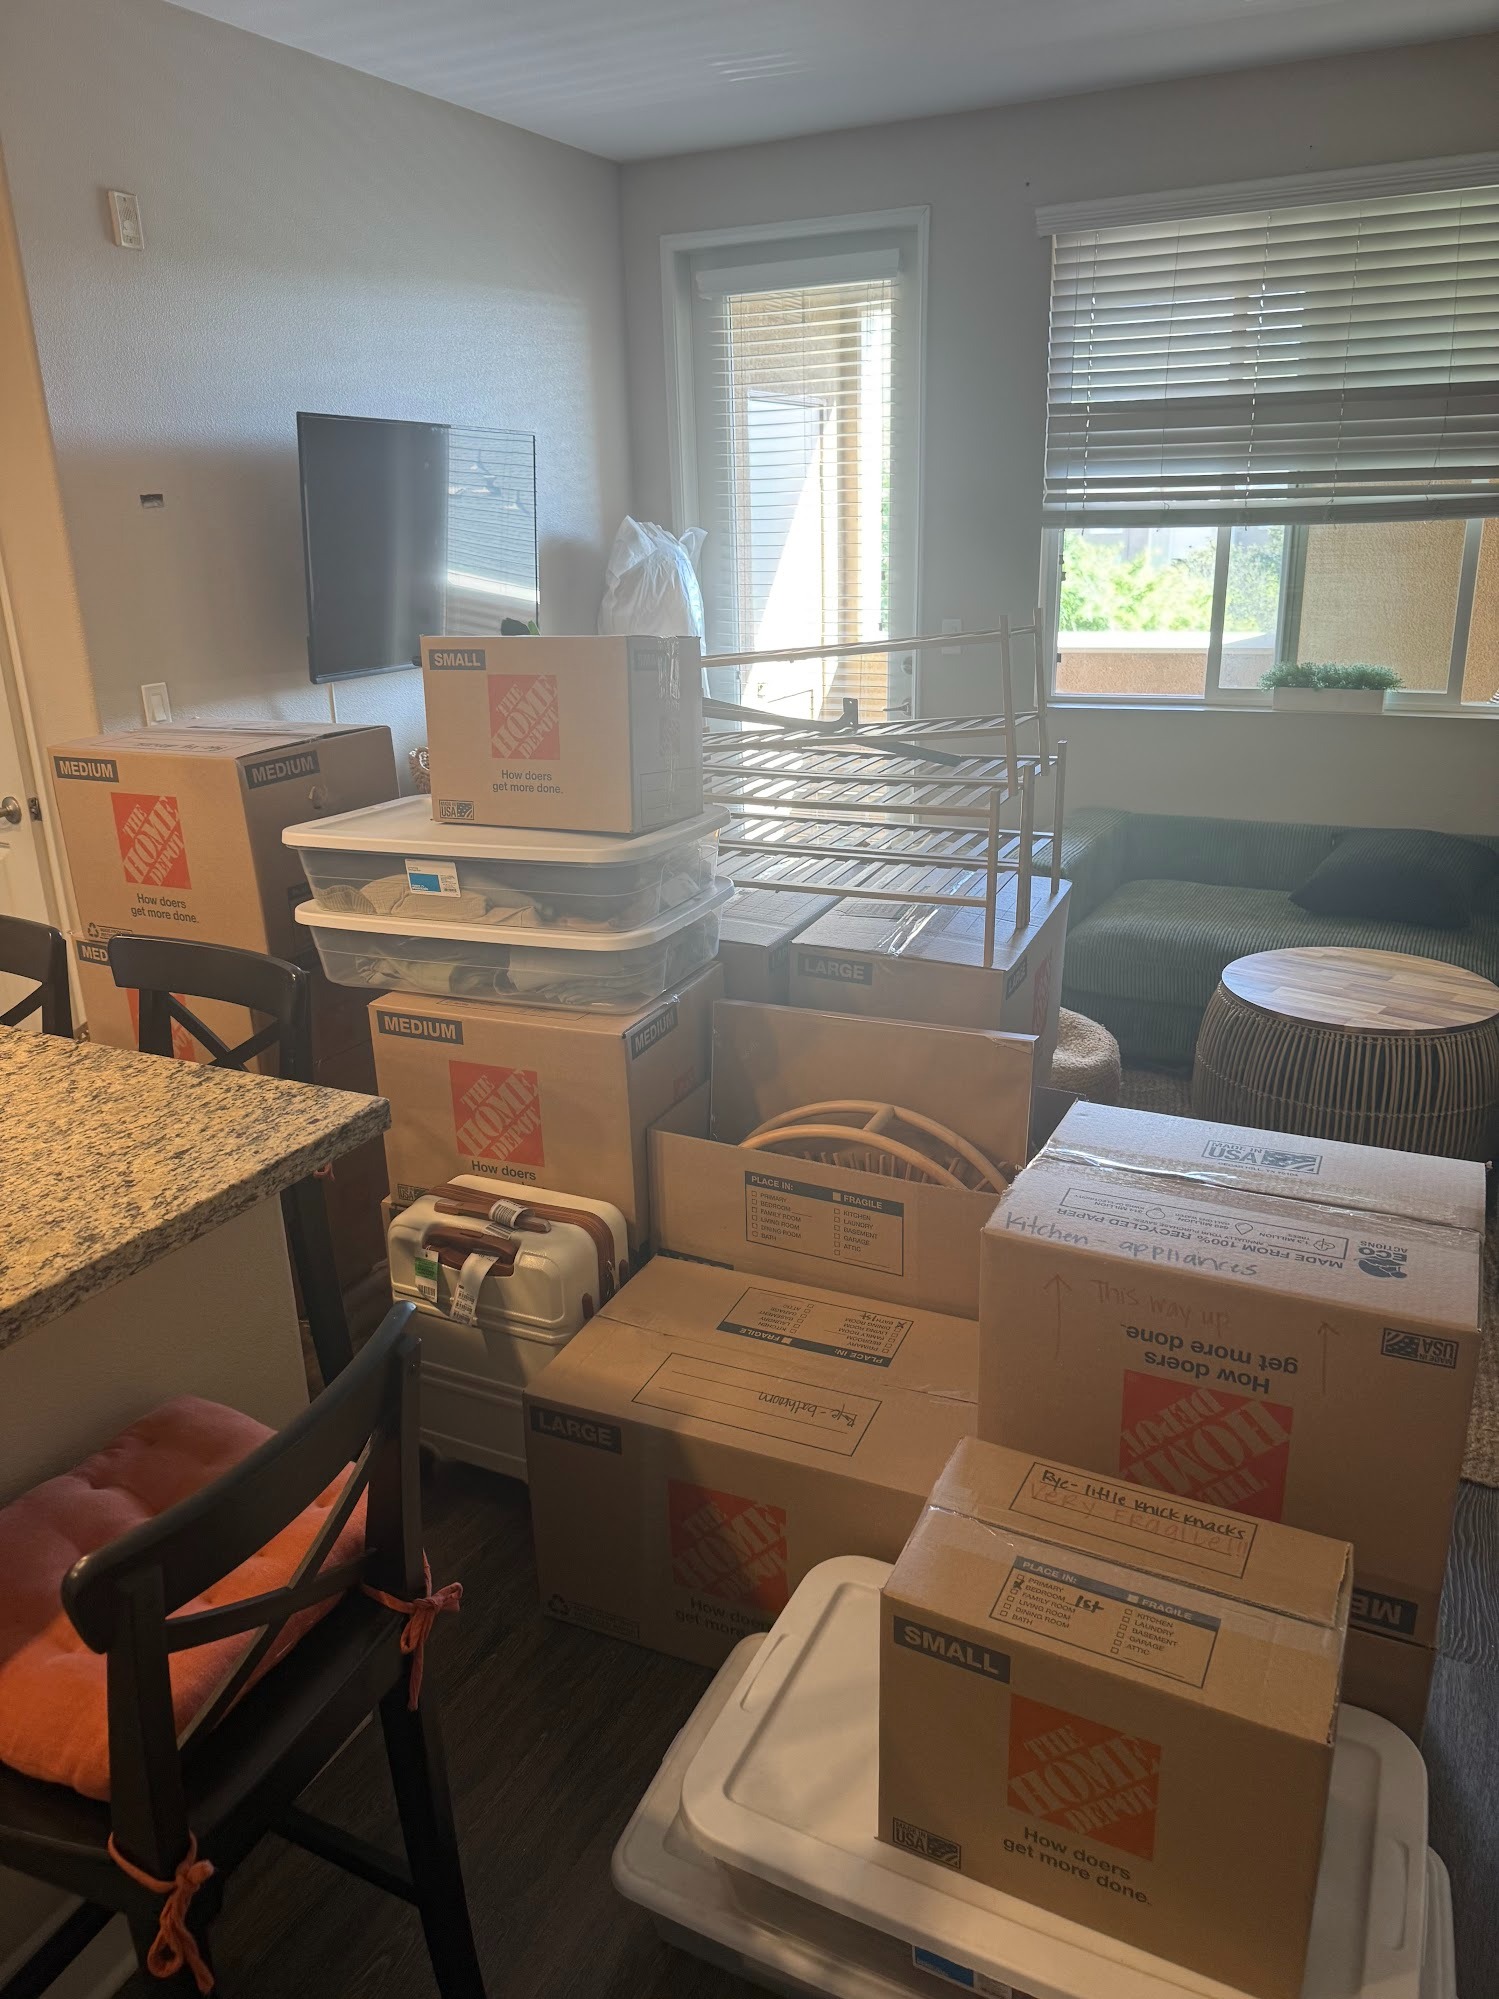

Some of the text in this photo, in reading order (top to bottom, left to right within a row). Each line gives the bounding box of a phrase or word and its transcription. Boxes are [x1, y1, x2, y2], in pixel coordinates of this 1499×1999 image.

[434, 652, 481, 667] SMALL
[495, 683, 525, 717] THE
[491, 673, 558, 759] HOME
[519, 707, 561, 759] DEPOT
[58, 760, 113, 779] MEDIUM
[251, 755, 315, 784] MEDIUM
[501, 769, 552, 781] How doers
[492, 782, 564, 795] get more done.
[441, 806, 457, 818] USA
[122, 803, 148, 840] THE
[122, 796, 180, 884] HOME
[149, 831, 184, 886] DEPOT
[136, 893, 187, 909] How doers
[130, 906, 200, 924] get more done.
[81, 946, 109, 962] MED
[804, 956, 865, 980] LARGE
[384, 1015, 457, 1040] MEDIUM
[634, 1011, 675, 1051] MEDIUM
[460, 1073, 498, 1112] THE
[456, 1067, 541, 1158] HOME
[490, 1106, 541, 1163] DEPOT
[1208, 1146, 1258, 1163] USA
[1211, 1141, 1246, 1152] MADE
[471, 1159, 537, 1181] How doers
[751, 1175, 794, 1191] PLACE IN:
[760, 1192, 787, 1203] PRIMARY
[843, 1194, 883, 1210] FRAGILE
[760, 1201, 791, 1212] BEDROOM
[1094, 1201, 1127, 1212] MILLION
[760, 1209, 802, 1222] FAMILY ROOM
[760, 1217, 800, 1230] LIVING ROOM
[843, 1210, 871, 1221] KITCHEN
[843, 1218, 874, 1229] LAUNDRY
[1177, 1217, 1210, 1228] MILLION
[760, 1225, 802, 1239] DINING ROOM
[761, 1233, 777, 1241] BATH
[843, 1227, 878, 1239] BASEMENT
[1006, 1212, 1089, 1245] Kitchen
[1159, 1223, 1200, 1235] PURCHASE
[1200, 1229, 1223, 1239] YOUR
[843, 1235, 870, 1246] GARAGE
[1057, 1208, 1344, 1269] MADE FROM 100% RECYCLED PAPER
[1225, 1235, 1264, 1246] ANNUALLY
[1259, 1232, 1295, 1243] MILLION
[843, 1243, 861, 1252] ATTIC
[1358, 1247, 1408, 1263] ECO
[1360, 1240, 1408, 1253] ACTIONS
[758, 1310, 794, 1321] BASEMENT
[1147, 1295, 1191, 1329] way
[757, 1322, 787, 1332] KITCHEN
[760, 1316, 790, 1327] LAUNDRY
[843, 1323, 888, 1335] LIVING ROOM
[845, 1317, 891, 1330] DINING ROOM
[876, 1317, 894, 1325] BATH
[739, 1327, 781, 1341] FRAGILE
[838, 1327, 885, 1341] FAMILY ROOM
[846, 1336, 882, 1346] BEDROOM
[846, 1341, 879, 1352] PRIMARY
[1120, 1323, 1298, 1375] get more done.
[1422, 1339, 1454, 1359] USA
[834, 1348, 884, 1364] PLACE IN:
[1419, 1353, 1454, 1366] MADE IN
[1143, 1351, 1270, 1394] How doers
[538, 1412, 613, 1446] LARGE
[1120, 1388, 1225, 1459] DEPOT
[1125, 1401, 1290, 1494] HOME
[1085, 1484, 1126, 1507] little
[1200, 1470, 1270, 1508] THE
[682, 1502, 728, 1536] THE
[673, 1503, 786, 1588] HOME
[707, 1546, 788, 1600] DEPOT
[1022, 1560, 1078, 1585] PLACE IN:
[1025, 1585, 1066, 1601] BEDROOM
[1028, 1577, 1064, 1593] PRIMARY
[1018, 1599, 1072, 1621] LIVING ROOM
[1021, 1592, 1076, 1613] FAMILY ROOM
[1075, 1595, 1105, 1614] 1st
[1142, 1599, 1193, 1621] FRAGILE
[674, 1609, 700, 1626] get
[690, 1597, 772, 1631] How doer
[1012, 1614, 1033, 1626] BATH
[1015, 1607, 1070, 1629] DINING ROOM
[1137, 1613, 1174, 1628] KITCHEN
[1132, 1628, 1179, 1647] BASEMENT
[1134, 1620, 1175, 1638] LAUNDRY
[903, 1626, 1000, 1675] SMALL
[1126, 1643, 1151, 1656] ATTIC
[1129, 1636, 1165, 1651] GARAGE
[1023, 1724, 1083, 1762] THE
[1008, 1734, 1162, 1817] HOME
[1063, 1784, 1160, 1835] DEPOT
[895, 1821, 928, 1838] MADE IN
[895, 1829, 926, 1853] USA
[1024, 1826, 1132, 1881] How doers
[1003, 1838, 1153, 1906] get more done.
